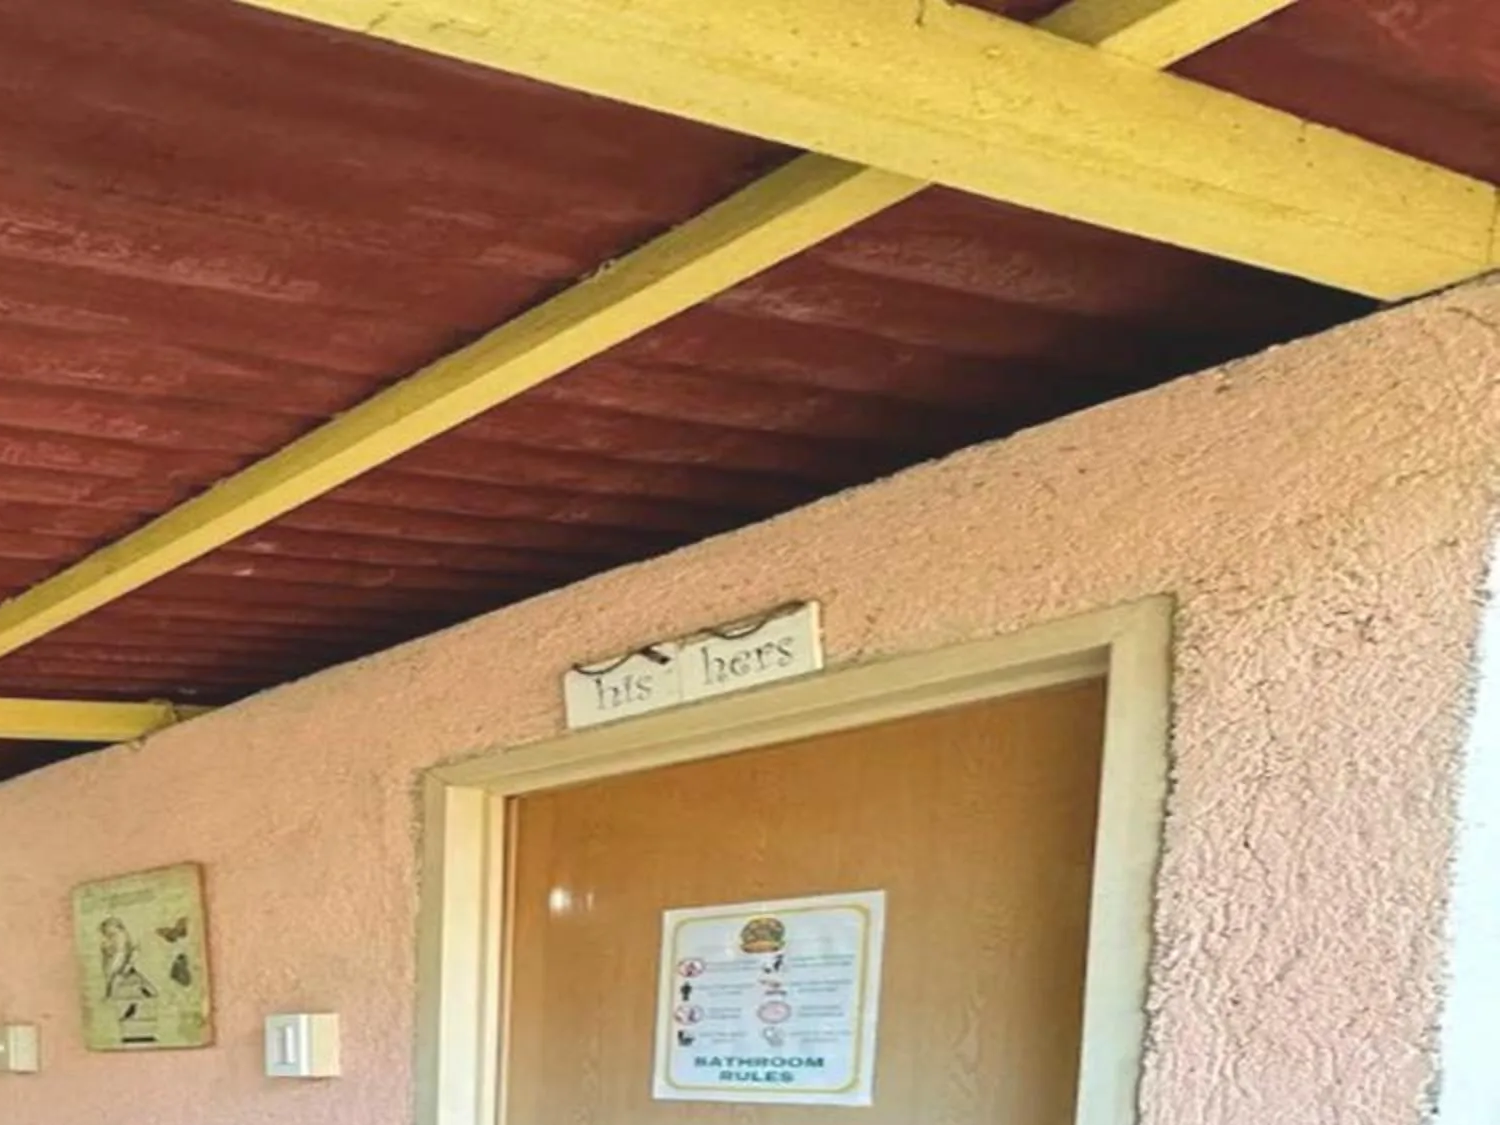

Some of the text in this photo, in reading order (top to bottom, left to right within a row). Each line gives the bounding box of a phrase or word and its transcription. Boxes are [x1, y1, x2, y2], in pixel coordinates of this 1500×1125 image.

[700, 636, 795, 686] hers
[694, 1055, 825, 1069] BATHROOM
[718, 1069, 794, 1083] RULES
